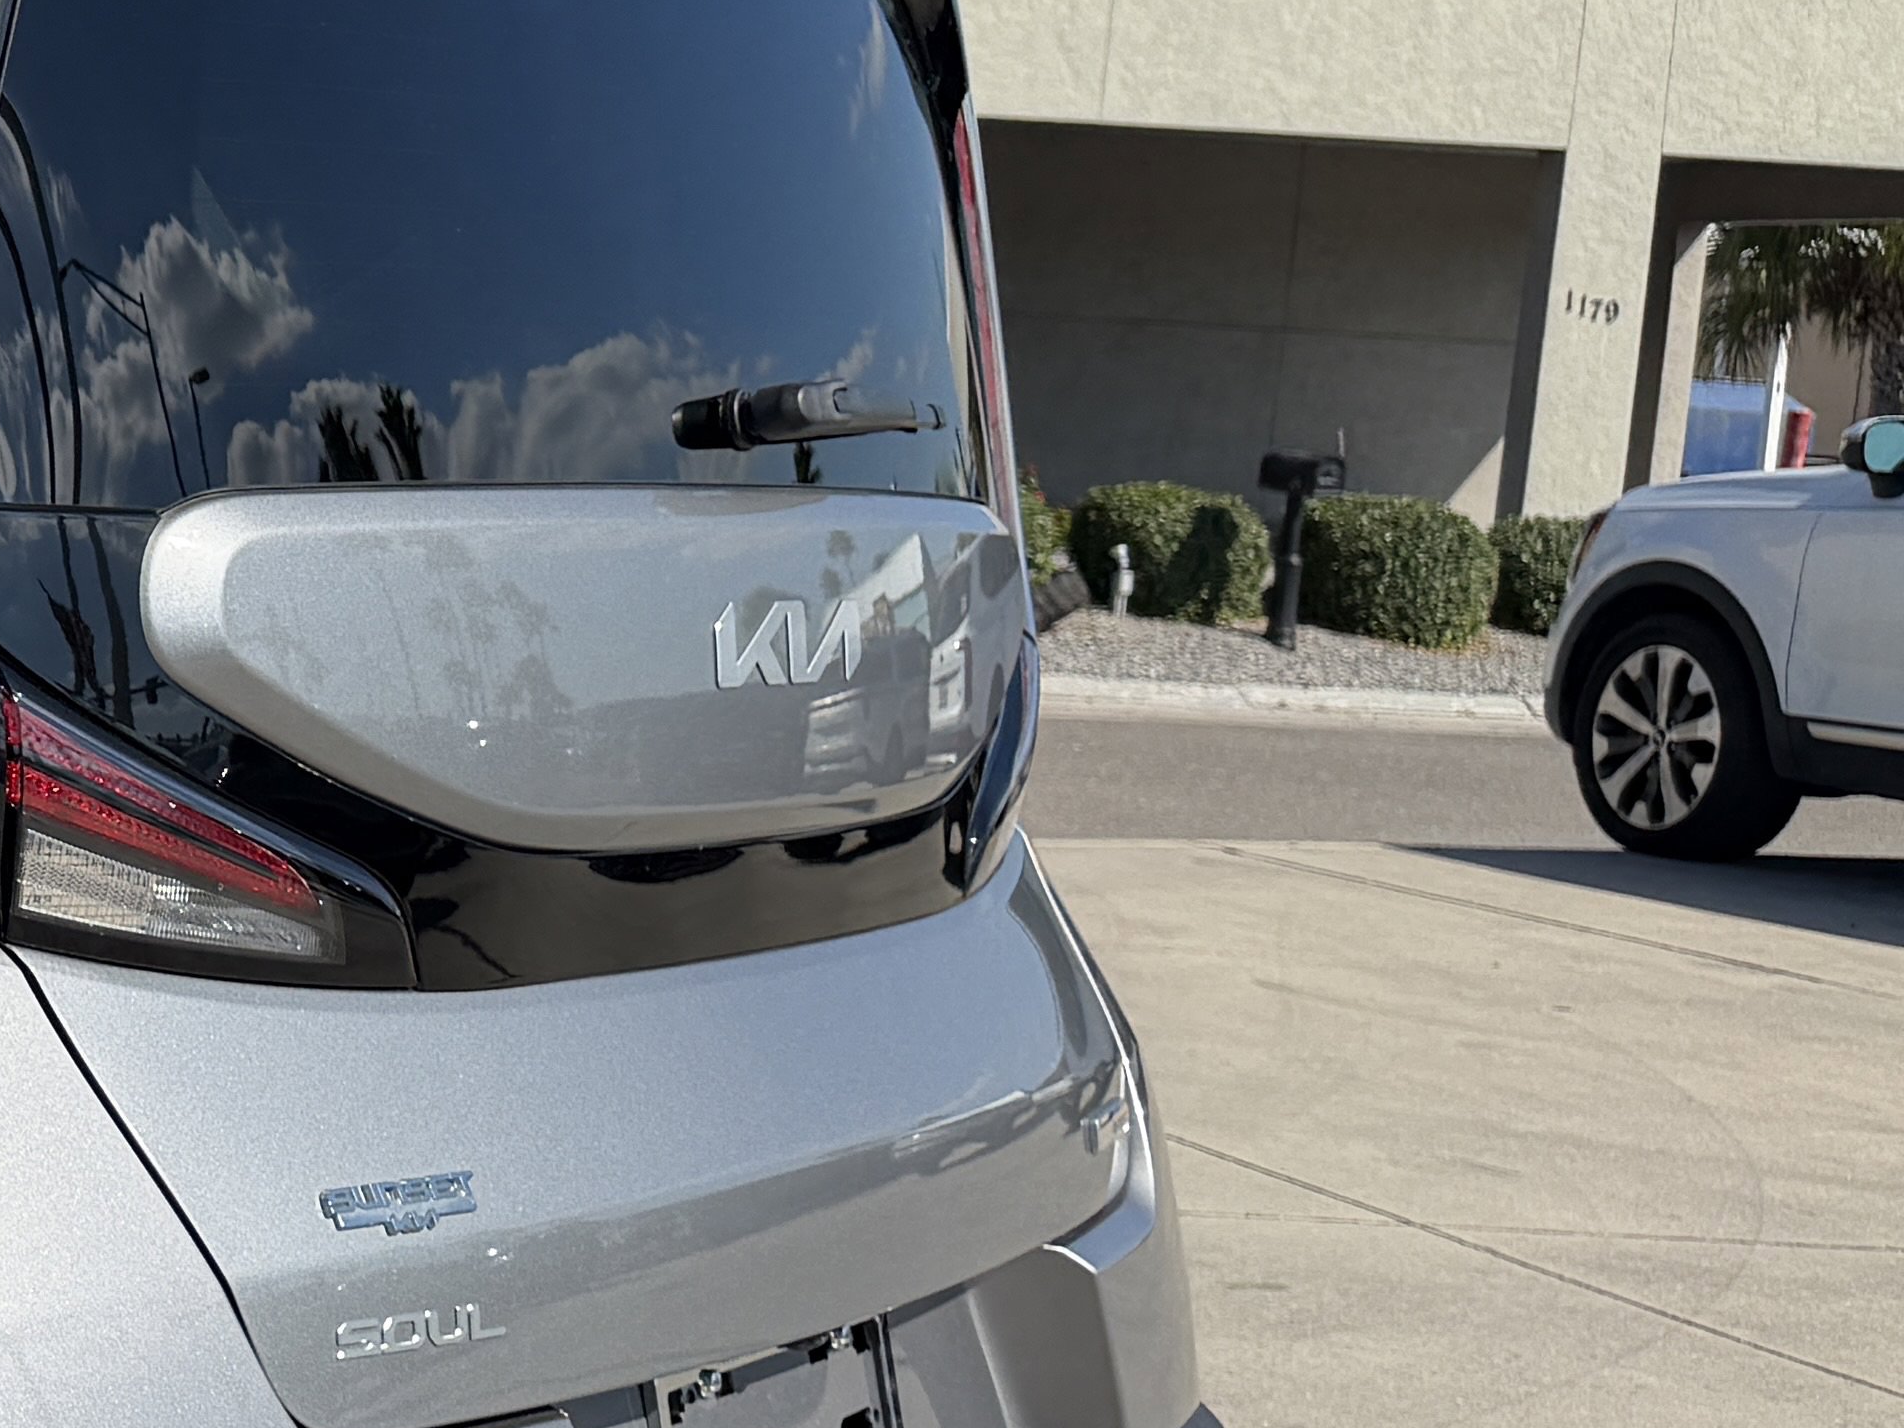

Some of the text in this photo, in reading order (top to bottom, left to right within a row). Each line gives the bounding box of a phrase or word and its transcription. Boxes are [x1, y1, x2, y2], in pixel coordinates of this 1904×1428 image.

[1565, 287, 1620, 325] 1179
[713, 599, 863, 689] KIA
[319, 1170, 475, 1219] SUNSET
[335, 1303, 507, 1360] SOUL
